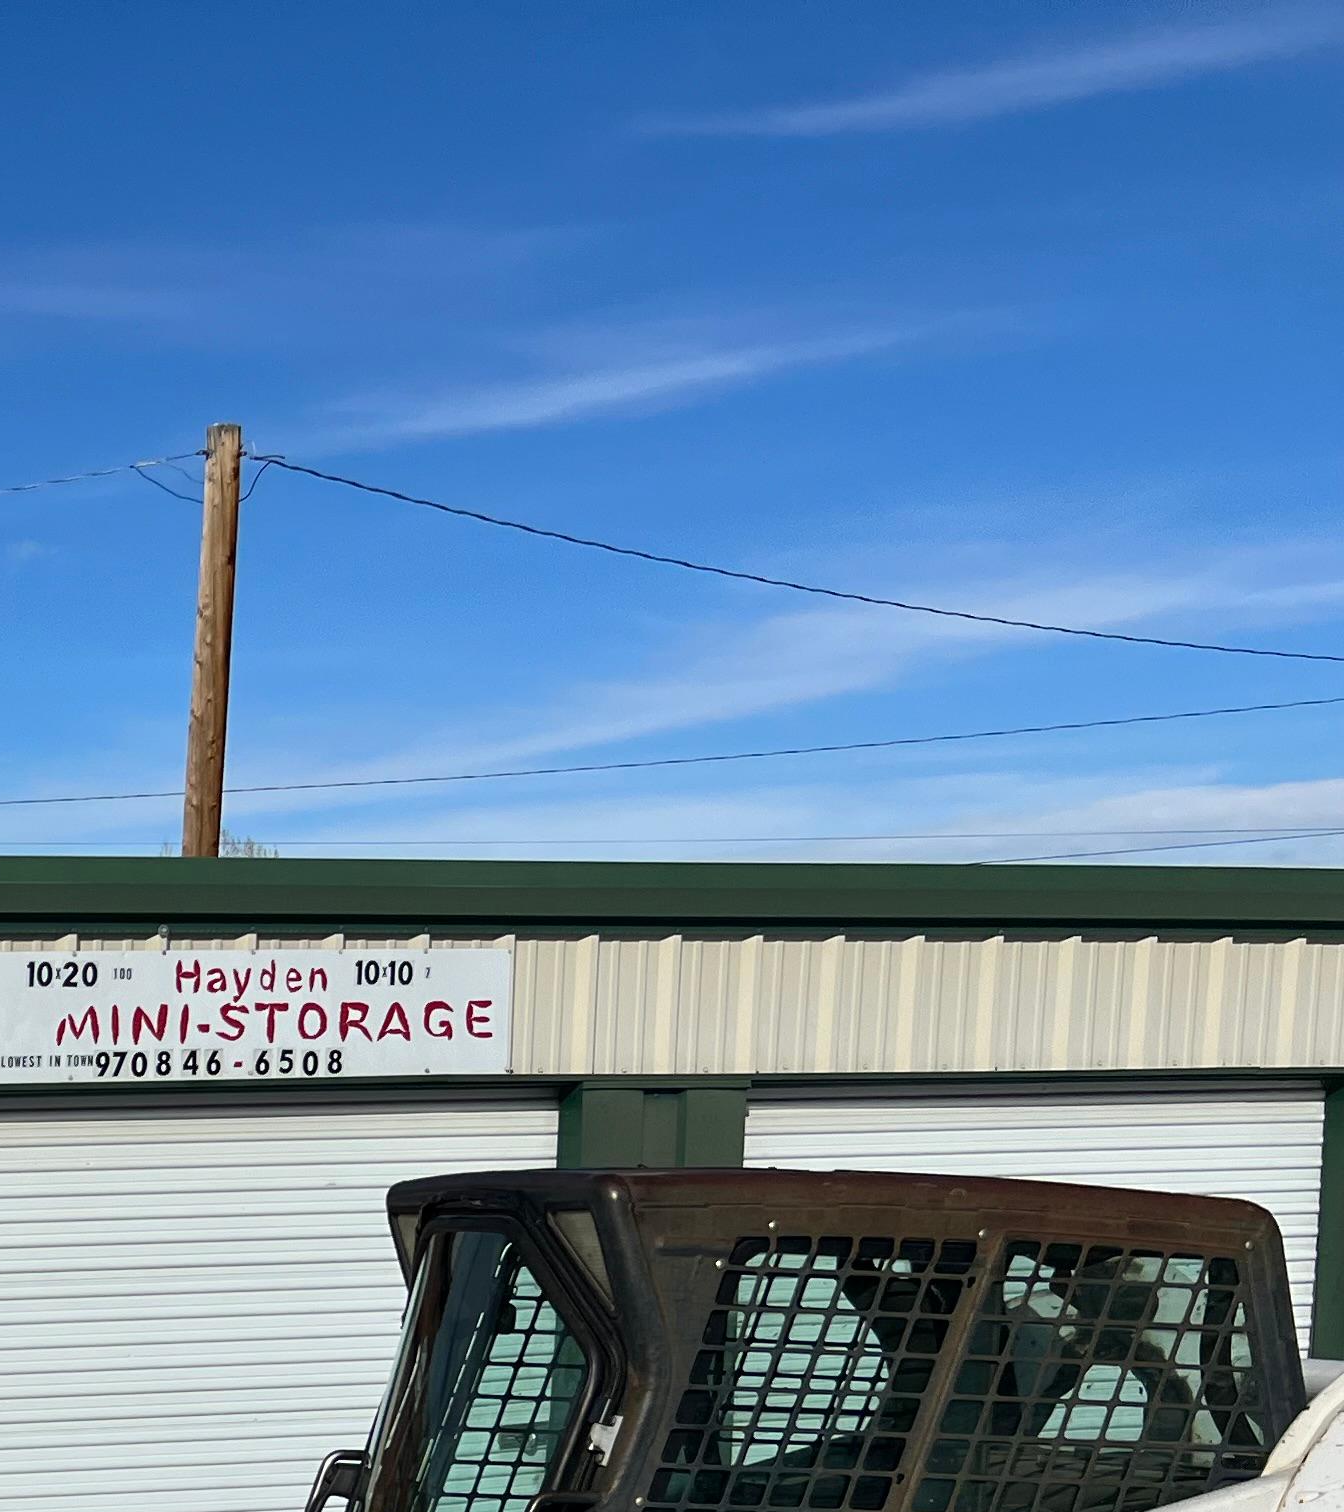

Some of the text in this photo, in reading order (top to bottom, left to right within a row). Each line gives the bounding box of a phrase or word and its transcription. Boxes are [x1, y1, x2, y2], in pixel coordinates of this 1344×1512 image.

[112, 966, 133, 981] 100
[175, 958, 329, 1003] Hayden
[55, 999, 494, 1047] MINI-STORAGE
[0, 1053, 94, 1069] LOWEST IN TOWN
